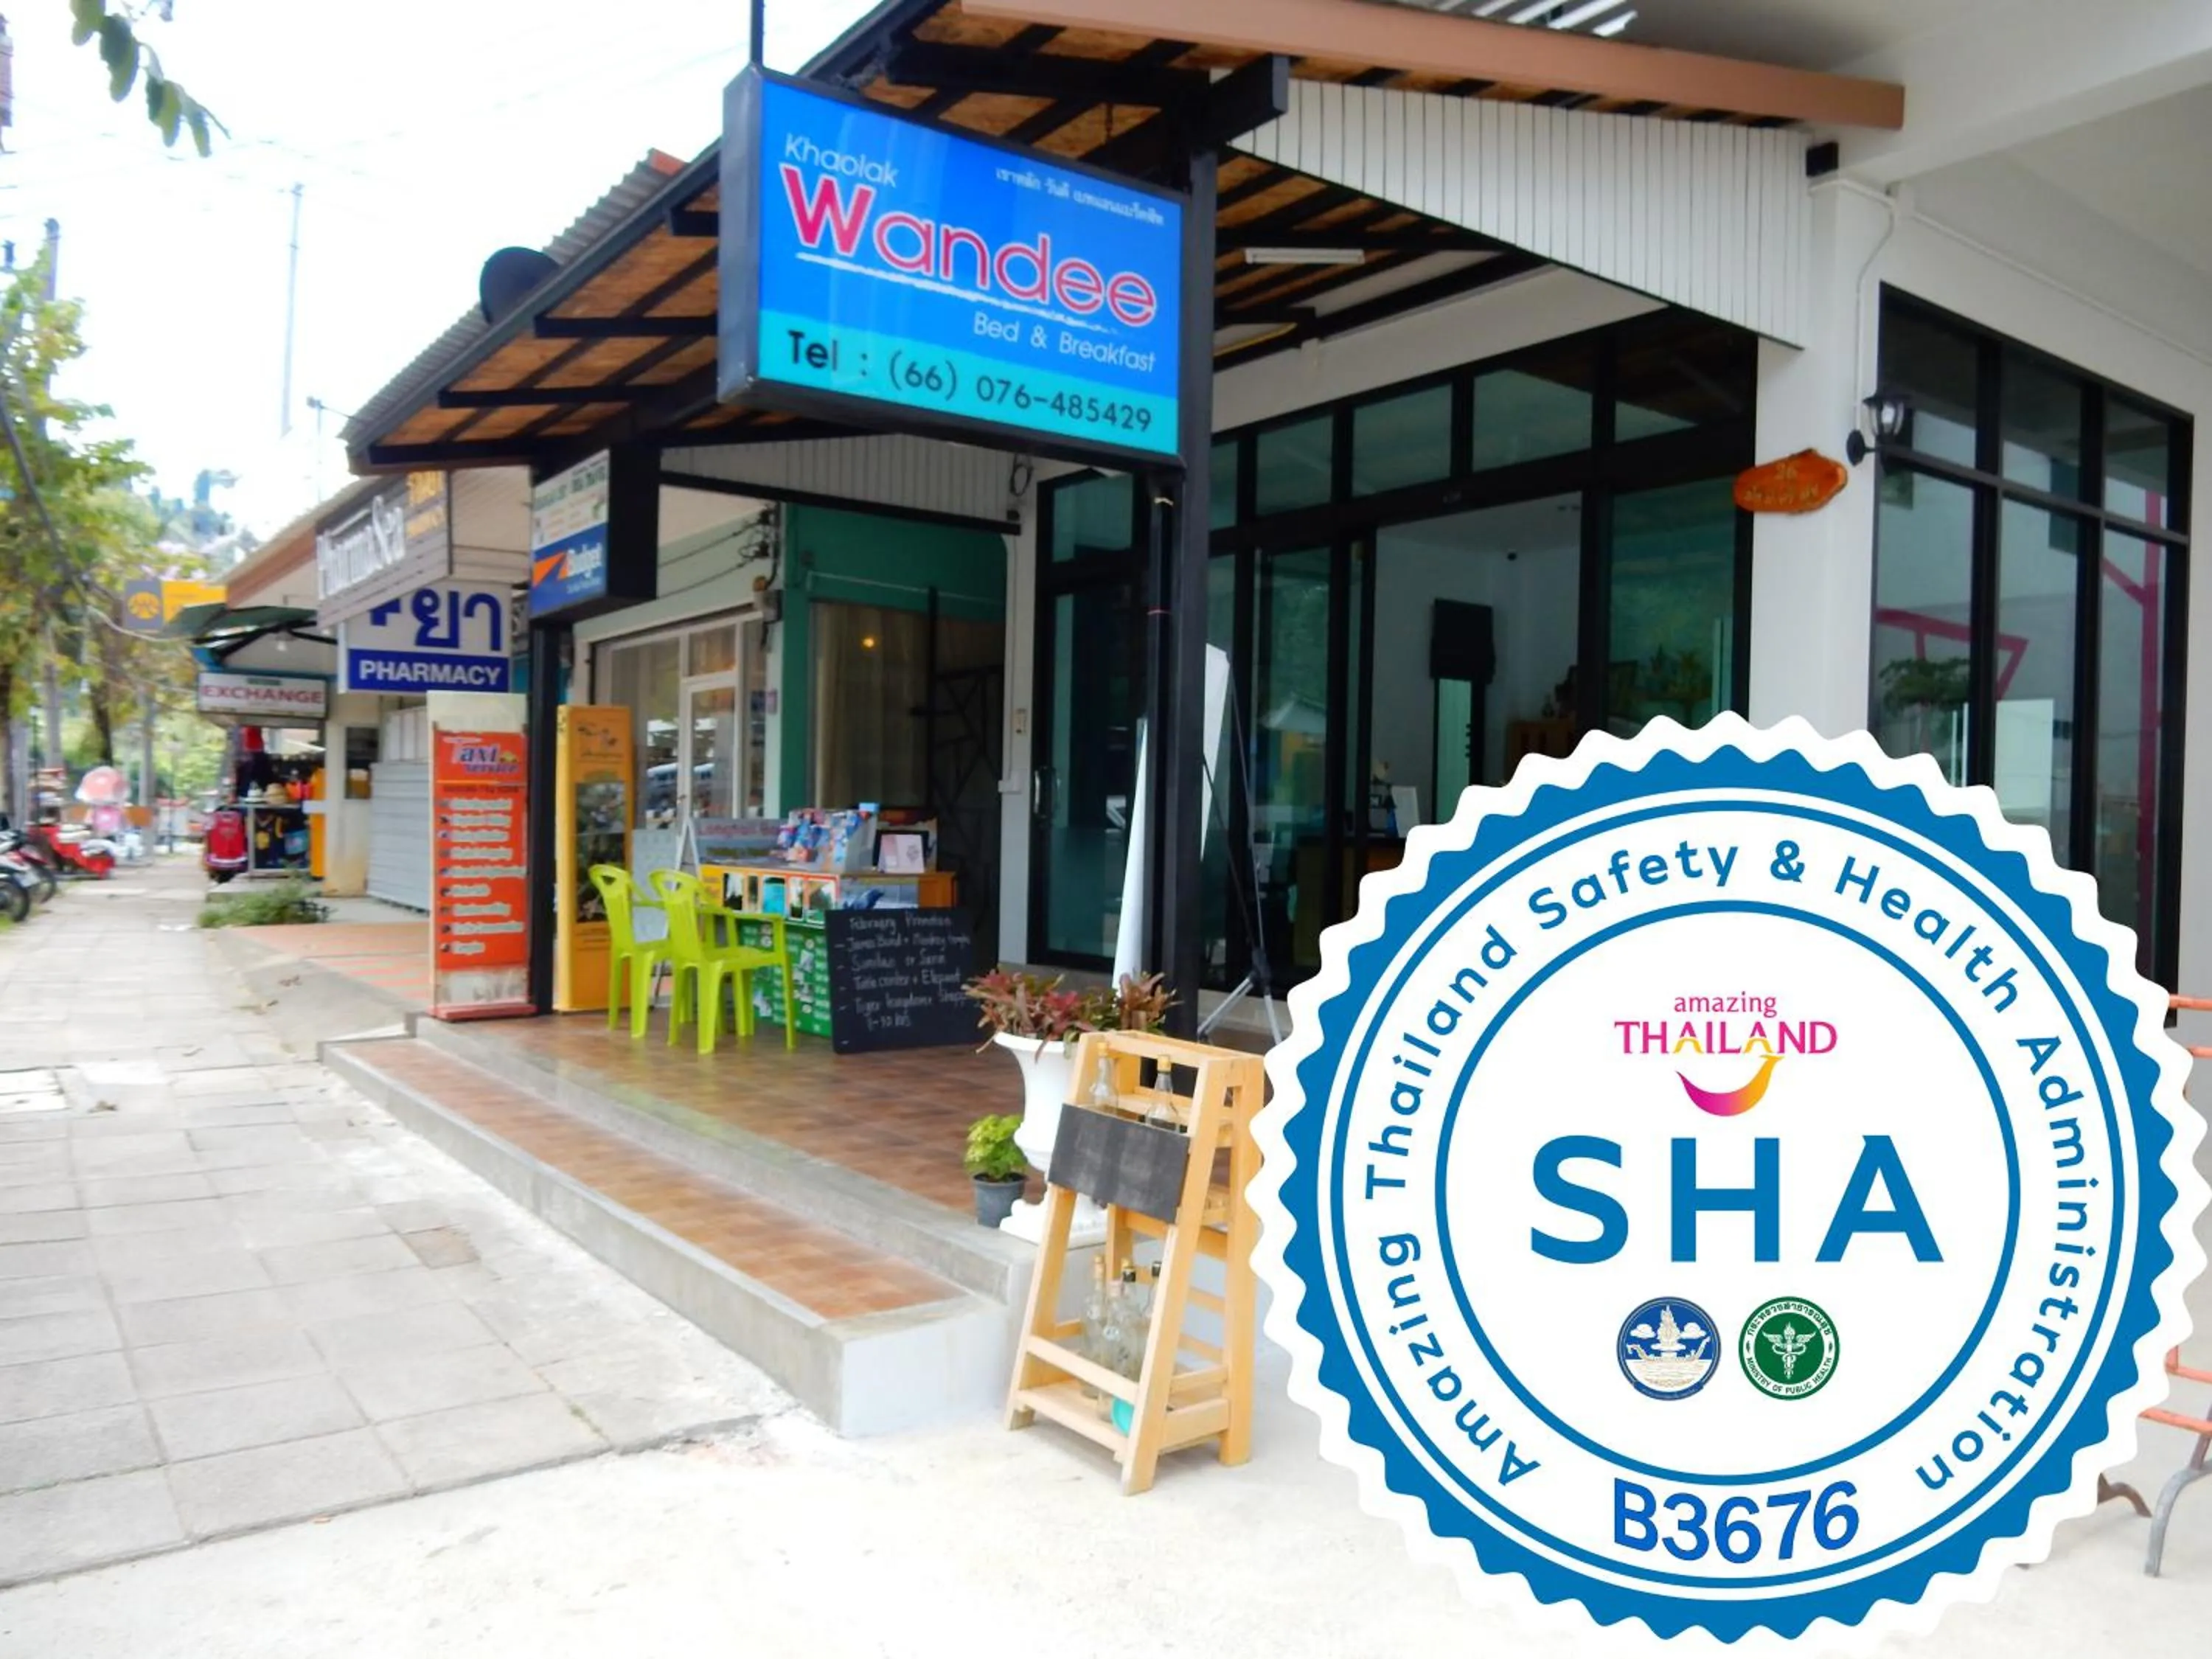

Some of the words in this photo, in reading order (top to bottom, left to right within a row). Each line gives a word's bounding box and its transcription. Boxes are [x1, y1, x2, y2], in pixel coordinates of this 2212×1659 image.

[785, 133, 897, 188] Khaolak
[779, 163, 1156, 327] Wandee
[974, 312, 1019, 343] Bed
[1030, 326, 1048, 349] &
[1060, 332, 1155, 372] Breakfast
[787, 330, 839, 372] Tel
[889, 350, 956, 400] (66)
[977, 375, 1152, 432] 076-485429
[202, 685, 322, 704] EXCHANGE
[359, 660, 501, 686] PHARMACY
